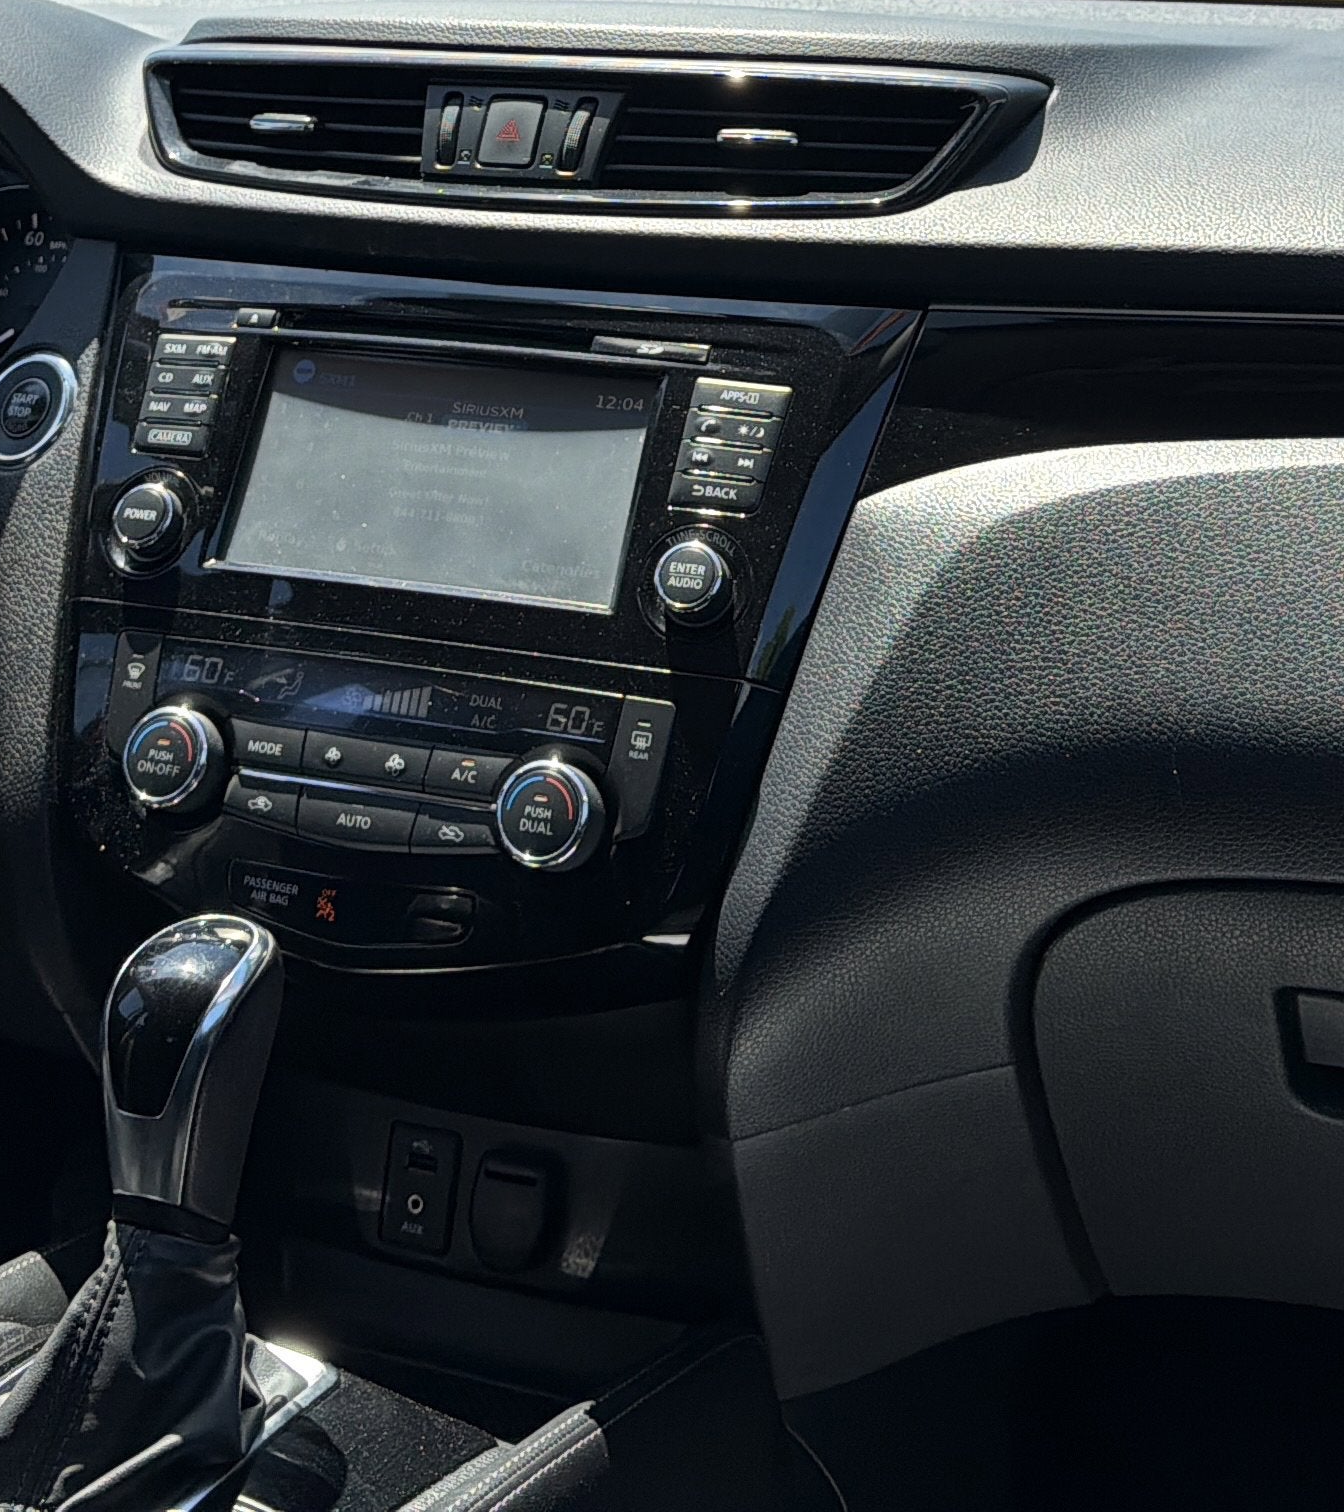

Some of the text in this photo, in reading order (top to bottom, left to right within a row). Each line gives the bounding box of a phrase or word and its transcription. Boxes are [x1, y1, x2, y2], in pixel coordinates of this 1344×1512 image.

[24, 231, 45, 247] 60
[163, 343, 187, 355] SXM
[158, 372, 215, 386] CD AUX
[11, 392, 40, 405] START
[595, 394, 645, 412] 12:04
[7, 406, 32, 418] STOP
[148, 400, 208, 414] NAV MAP
[451, 400, 525, 420] SIRIUSXM
[150, 430, 192, 444] CAMERA
[705, 485, 738, 501] BACK
[123, 507, 158, 522] POWER
[669, 561, 707, 576] ENTER
[667, 575, 704, 590] AUDIO
[469, 694, 504, 711] DUAL
[471, 714, 497, 729] A/C
[148, 748, 174, 762] PUSH
[247, 738, 284, 757] MODE
[628, 750, 649, 761] REAR
[450, 767, 478, 784] A/C
[523, 804, 552, 820] PUSH
[335, 812, 372, 830] AUTO
[519, 819, 554, 836] DUAL
[243, 874, 299, 896] PASSENGER
[249, 890, 289, 907] AIR BAG
